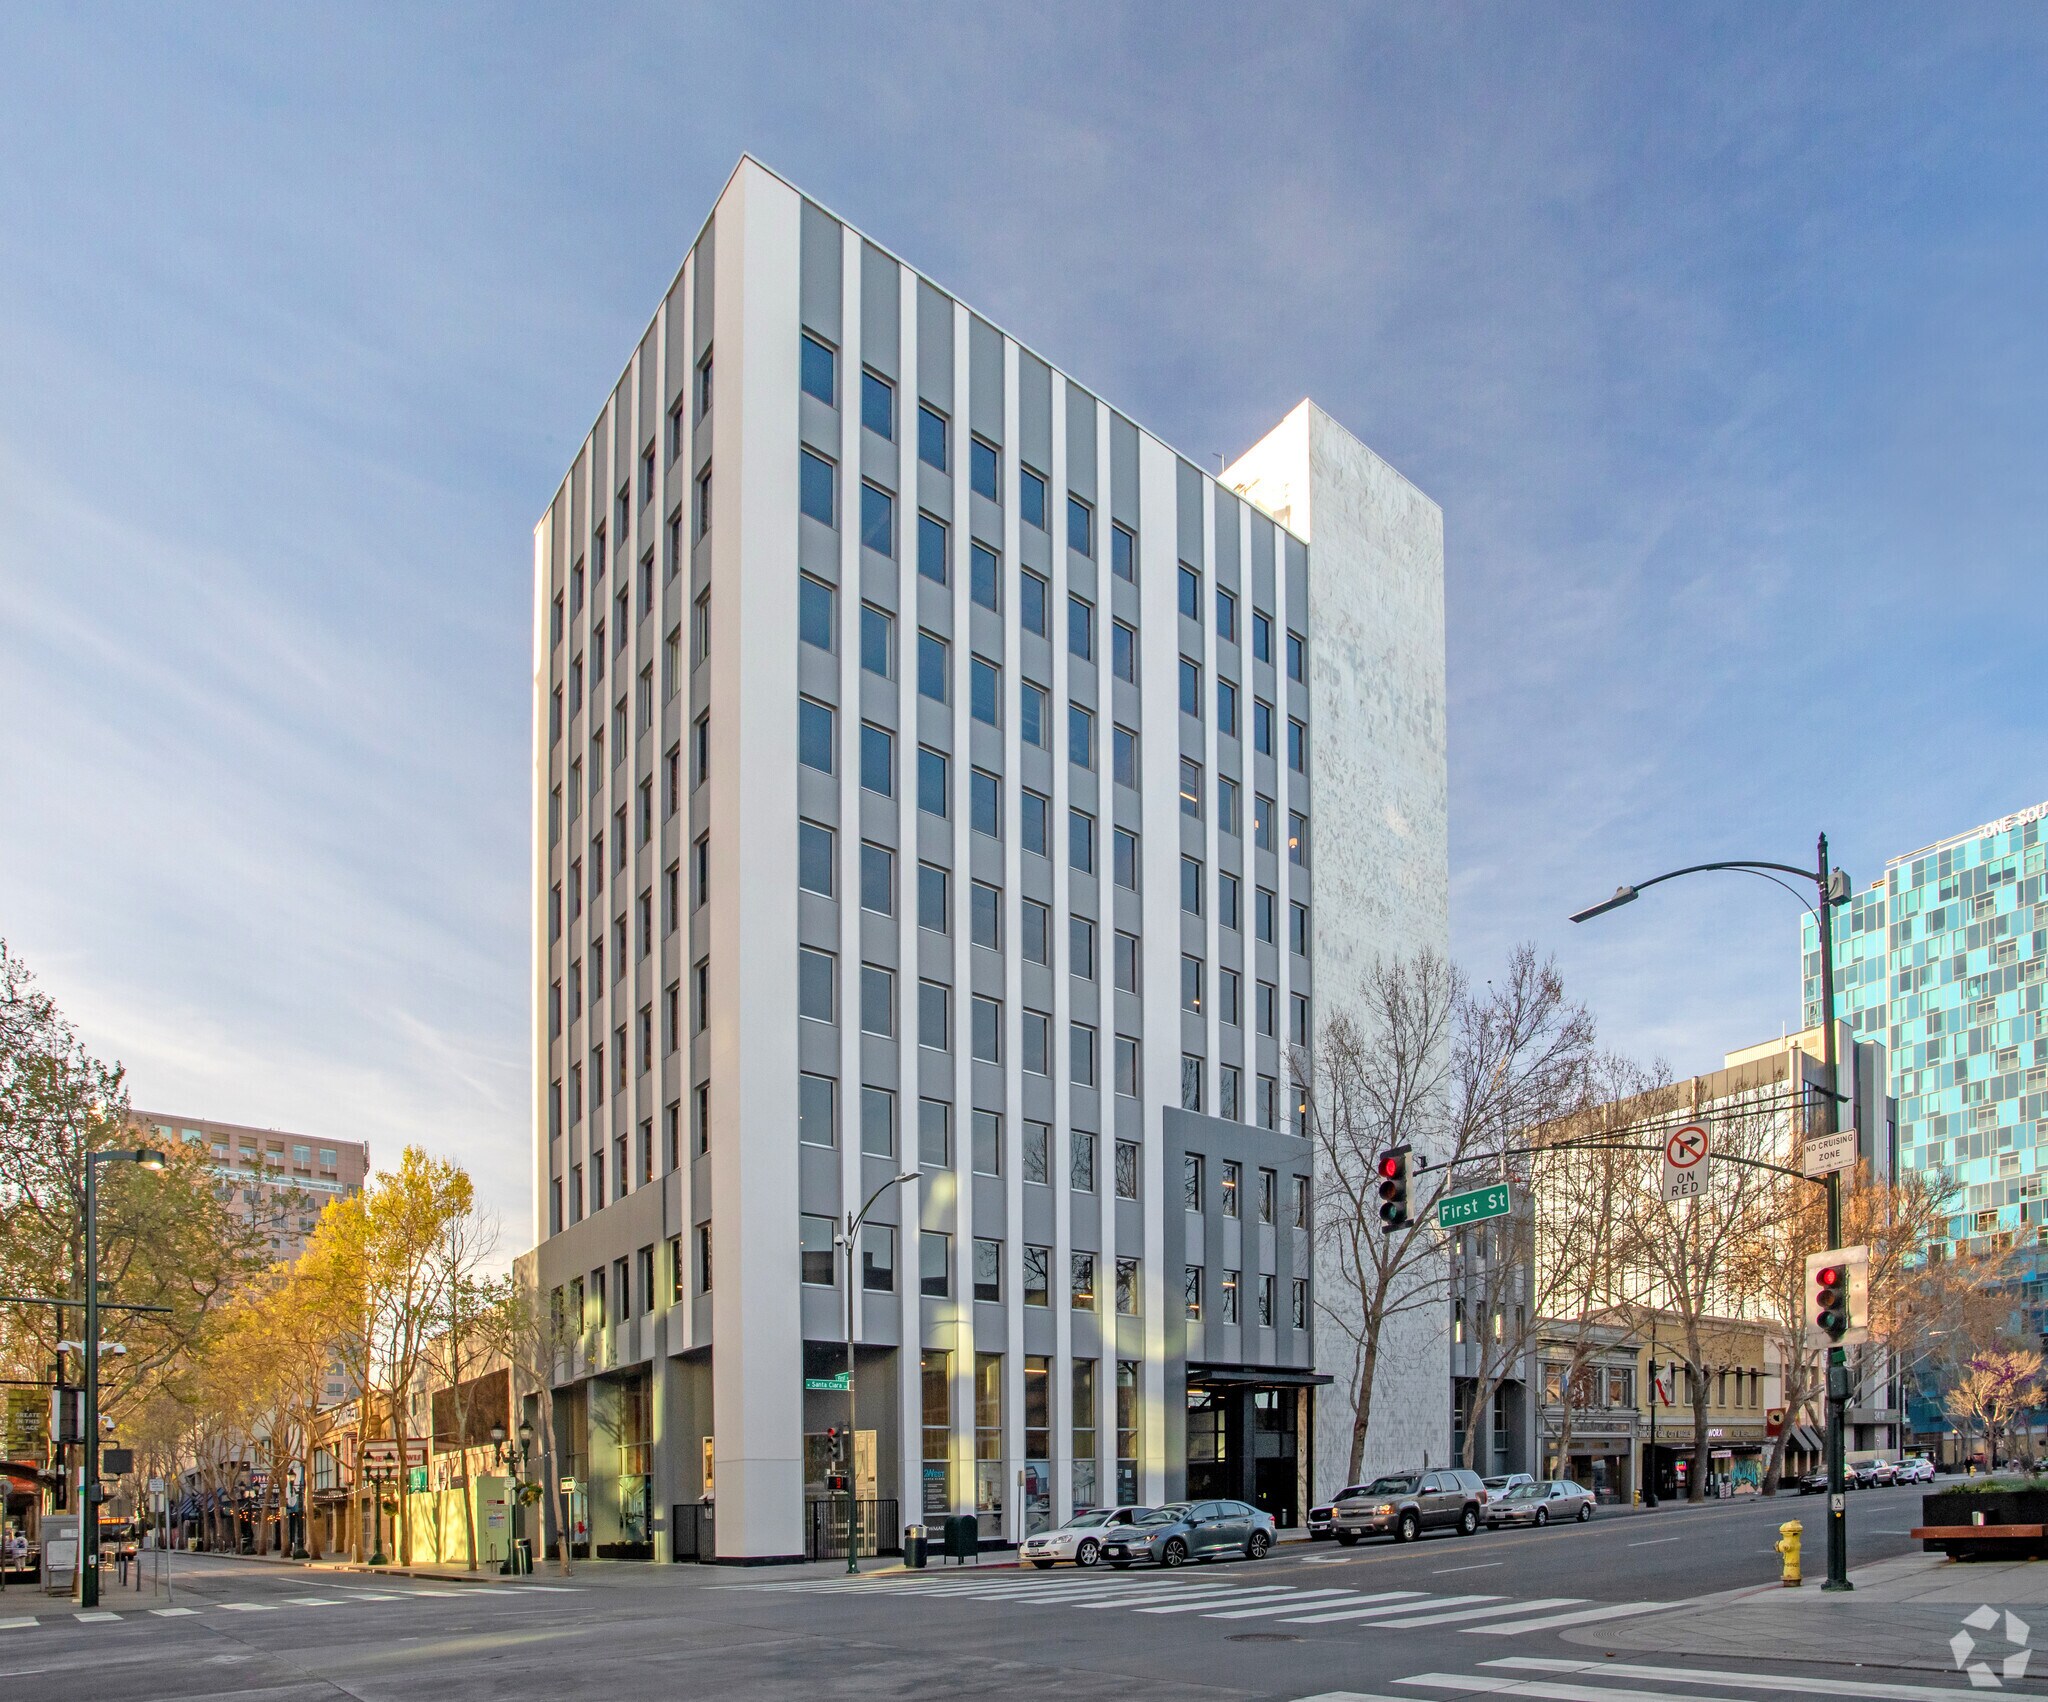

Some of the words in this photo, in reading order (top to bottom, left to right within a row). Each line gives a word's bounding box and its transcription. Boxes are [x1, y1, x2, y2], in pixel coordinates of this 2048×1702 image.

[1984, 817, 2014, 838] ONE
[2017, 801, 2048, 827] SOU
[1806, 1144, 1816, 1152] NO
[1818, 1134, 1853, 1150] CRUISING
[1819, 1149, 1840, 1161] ZONE
[1677, 1170, 1694, 1184] ON
[1671, 1181, 1698, 1196] RED
[1441, 1198, 1478, 1221] First
[1488, 1192, 1505, 1209] St
